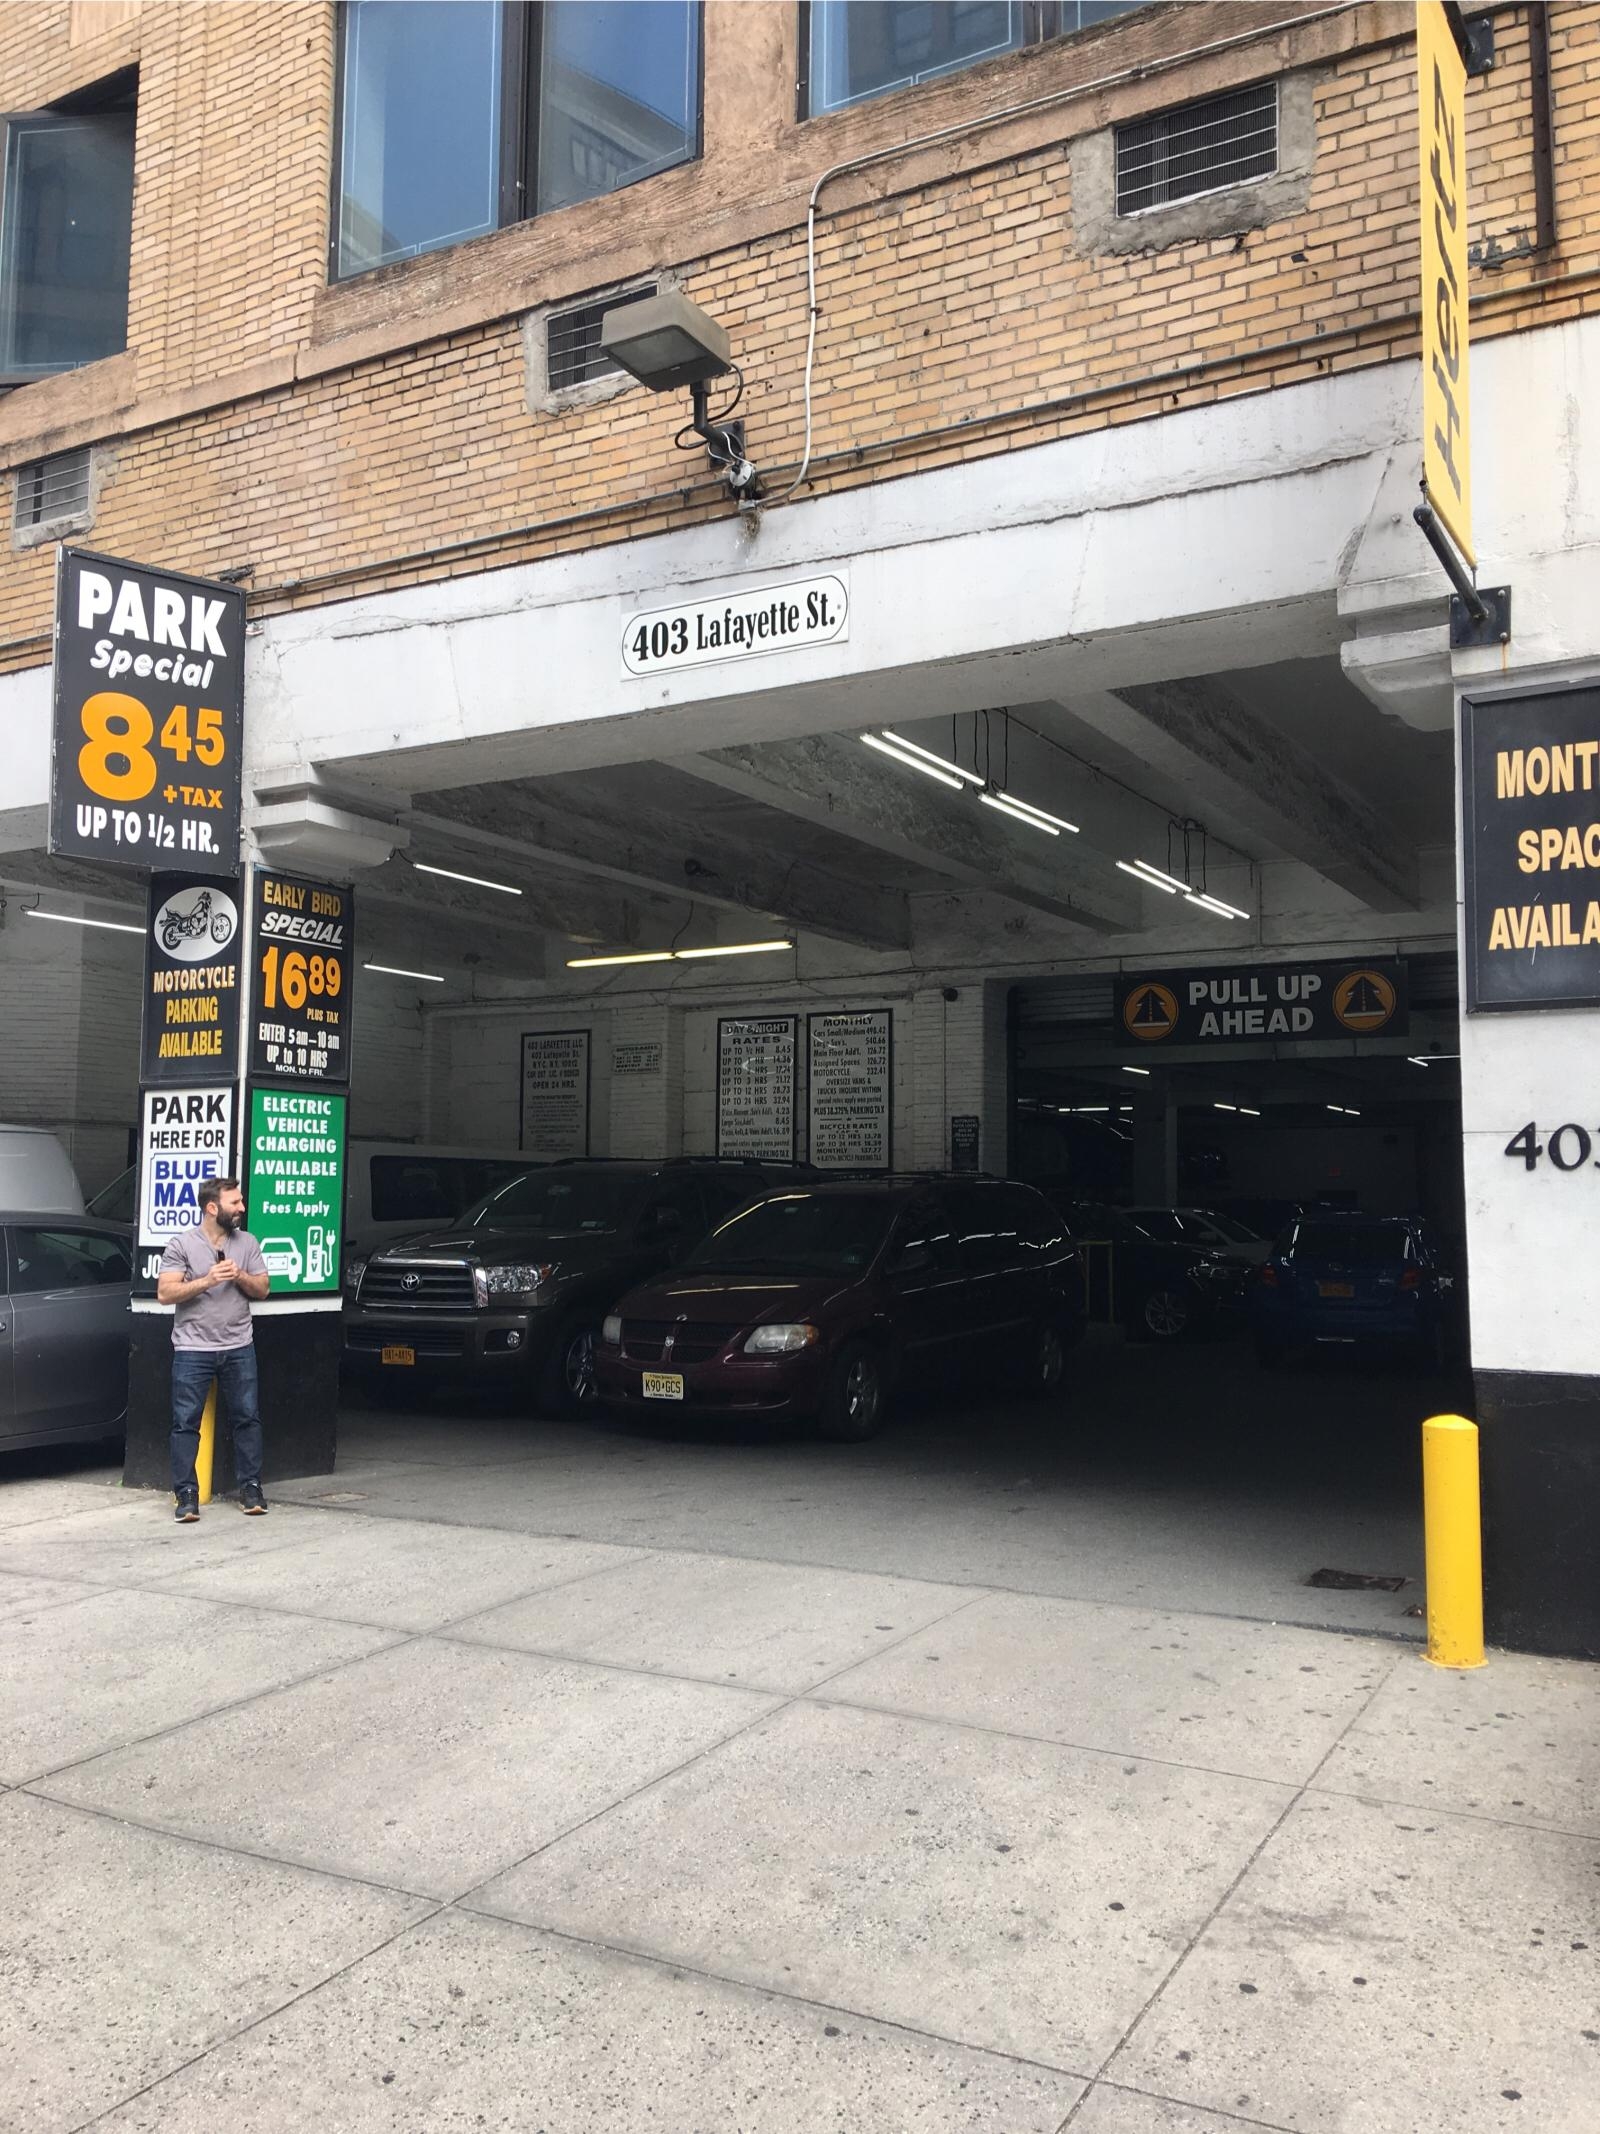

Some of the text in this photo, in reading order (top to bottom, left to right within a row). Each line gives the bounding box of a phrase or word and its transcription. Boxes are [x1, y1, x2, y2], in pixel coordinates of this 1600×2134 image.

[1431, 52, 1462, 504] Hertz
[79, 570, 227, 657] PARK
[632, 591, 836, 662] 403 Lafayette St.
[90, 639, 214, 689] Special
[1497, 741, 1600, 799] MONT
[77, 804, 106, 838] UP
[112, 810, 141, 843] TO
[182, 820, 219, 854] HR.
[264, 880, 341, 917] EARLY BIRD
[261, 912, 343, 945] SPECIAL
[154, 966, 235, 993] MOTORCYCLE
[1189, 974, 1321, 1005] PULL UP
[166, 996, 218, 1024] PARKING
[307, 1008, 338, 1024] PLUS TAX
[756, 1024, 787, 1033] NIGHT
[824, 1017, 873, 1027] MONTHLY
[1199, 1007, 1313, 1036] AHEAD
[259, 1023, 285, 1043] ENTER
[733, 1036, 780, 1044] RATES
[159, 1030, 222, 1058] AVAILABLE
[867, 1047, 885, 1055] 126.72
[267, 1045, 327, 1068] UP to 10 HRS
[723, 1057, 731, 1065] UP
[734, 1057, 742, 1065] TO
[814, 1057, 885, 1067] Assigned Spaces 126.72
[276, 1064, 323, 1077] MON. to FRI.
[814, 1069, 850, 1077] MOTORCYCLE
[533, 1081, 549, 1089] OPEN
[755, 1076, 768, 1084] HRS
[773, 1086, 790, 1094] 28.73
[151, 1095, 226, 1124] PARK
[263, 1097, 331, 1115] ELECTRIC
[755, 1097, 767, 1105] HRS
[850, 1106, 873, 1114] PARKING
[875, 1105, 884, 1113] TAX
[776, 1107, 790, 1115] 4.23
[267, 1117, 328, 1134] VEHICLE
[776, 1117, 789, 1125] 8.45
[150, 1130, 225, 1149] HERE FOR
[256, 1137, 336, 1153] CHARGING
[1505, 1121, 1600, 1171] 40
[155, 1160, 217, 1180] BLUE
[255, 1160, 337, 1176] AVAILABLE
[154, 1183, 201, 1207] MA
[275, 1181, 315, 1195] HERE
[263, 1201, 330, 1217] Fees Apply
[154, 1210, 203, 1226] GROU
